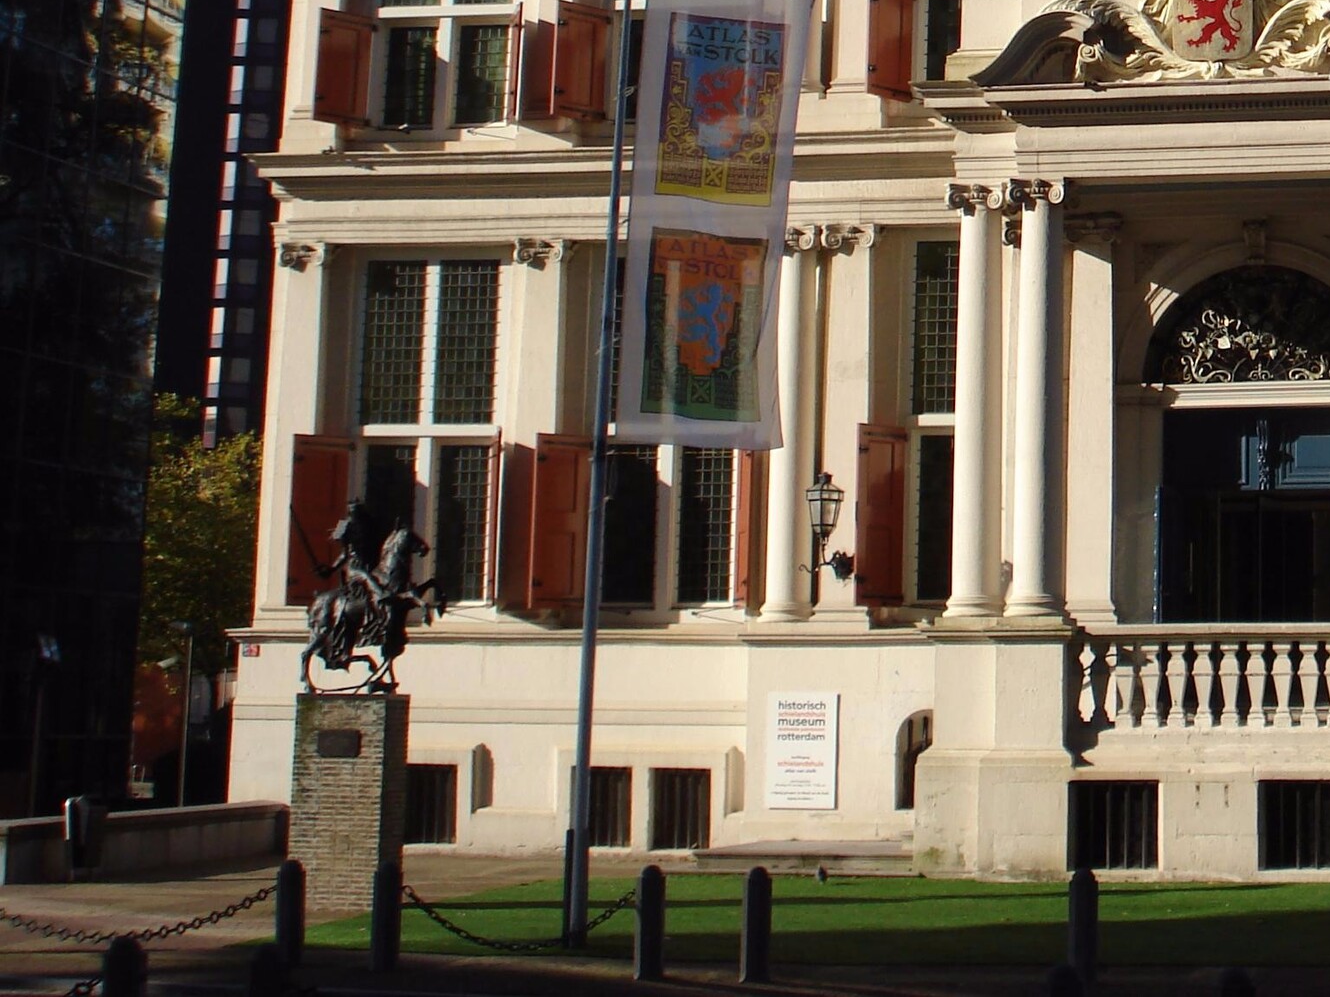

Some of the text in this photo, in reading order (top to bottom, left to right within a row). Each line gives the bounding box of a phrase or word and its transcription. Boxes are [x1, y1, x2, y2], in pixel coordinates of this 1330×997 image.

[687, 24, 771, 45] ATLAS
[704, 44, 779, 65] STOLK
[669, 238, 749, 260] ATLAS
[778, 700, 826, 710] historisch
[778, 718, 826, 726] museum
[777, 732, 826, 741] rotterdam
